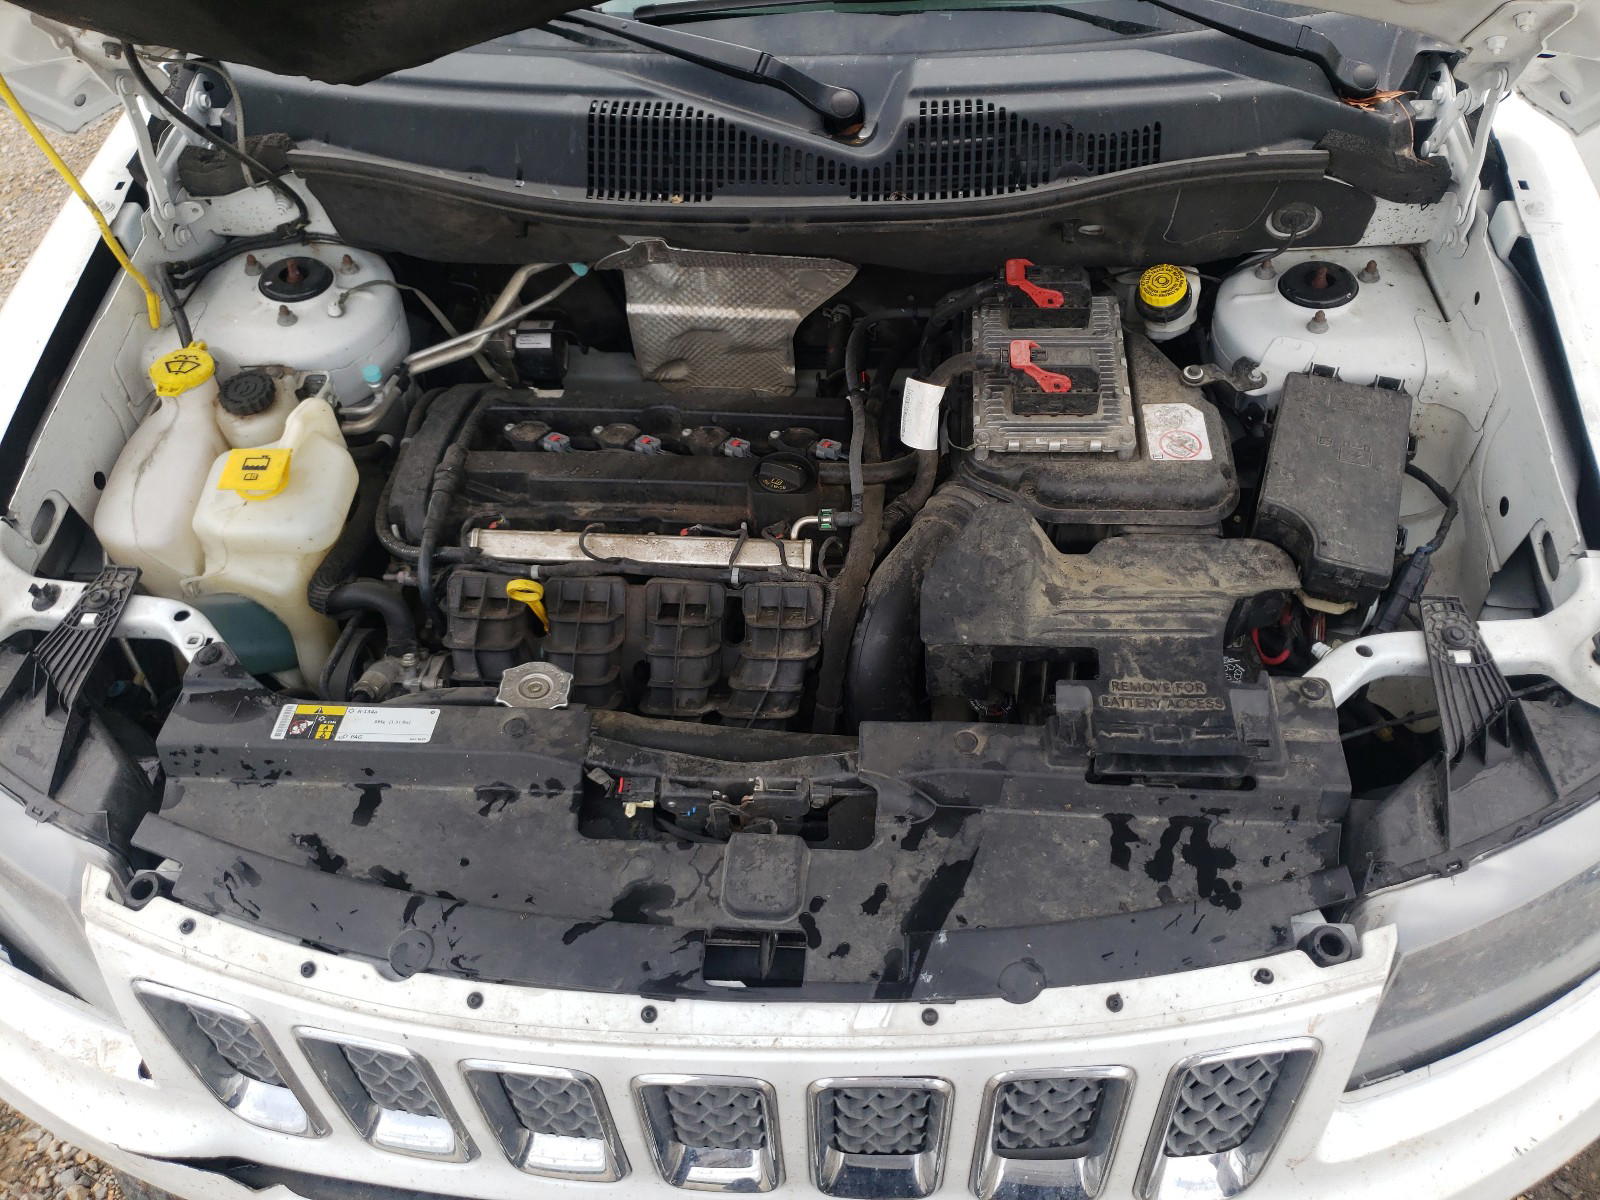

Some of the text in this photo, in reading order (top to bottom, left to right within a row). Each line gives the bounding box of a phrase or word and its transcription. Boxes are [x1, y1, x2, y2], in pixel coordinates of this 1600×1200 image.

[1111, 680, 1206, 695] REMOVE FOR
[1101, 695, 1226, 710] BATTERY ACCESS
